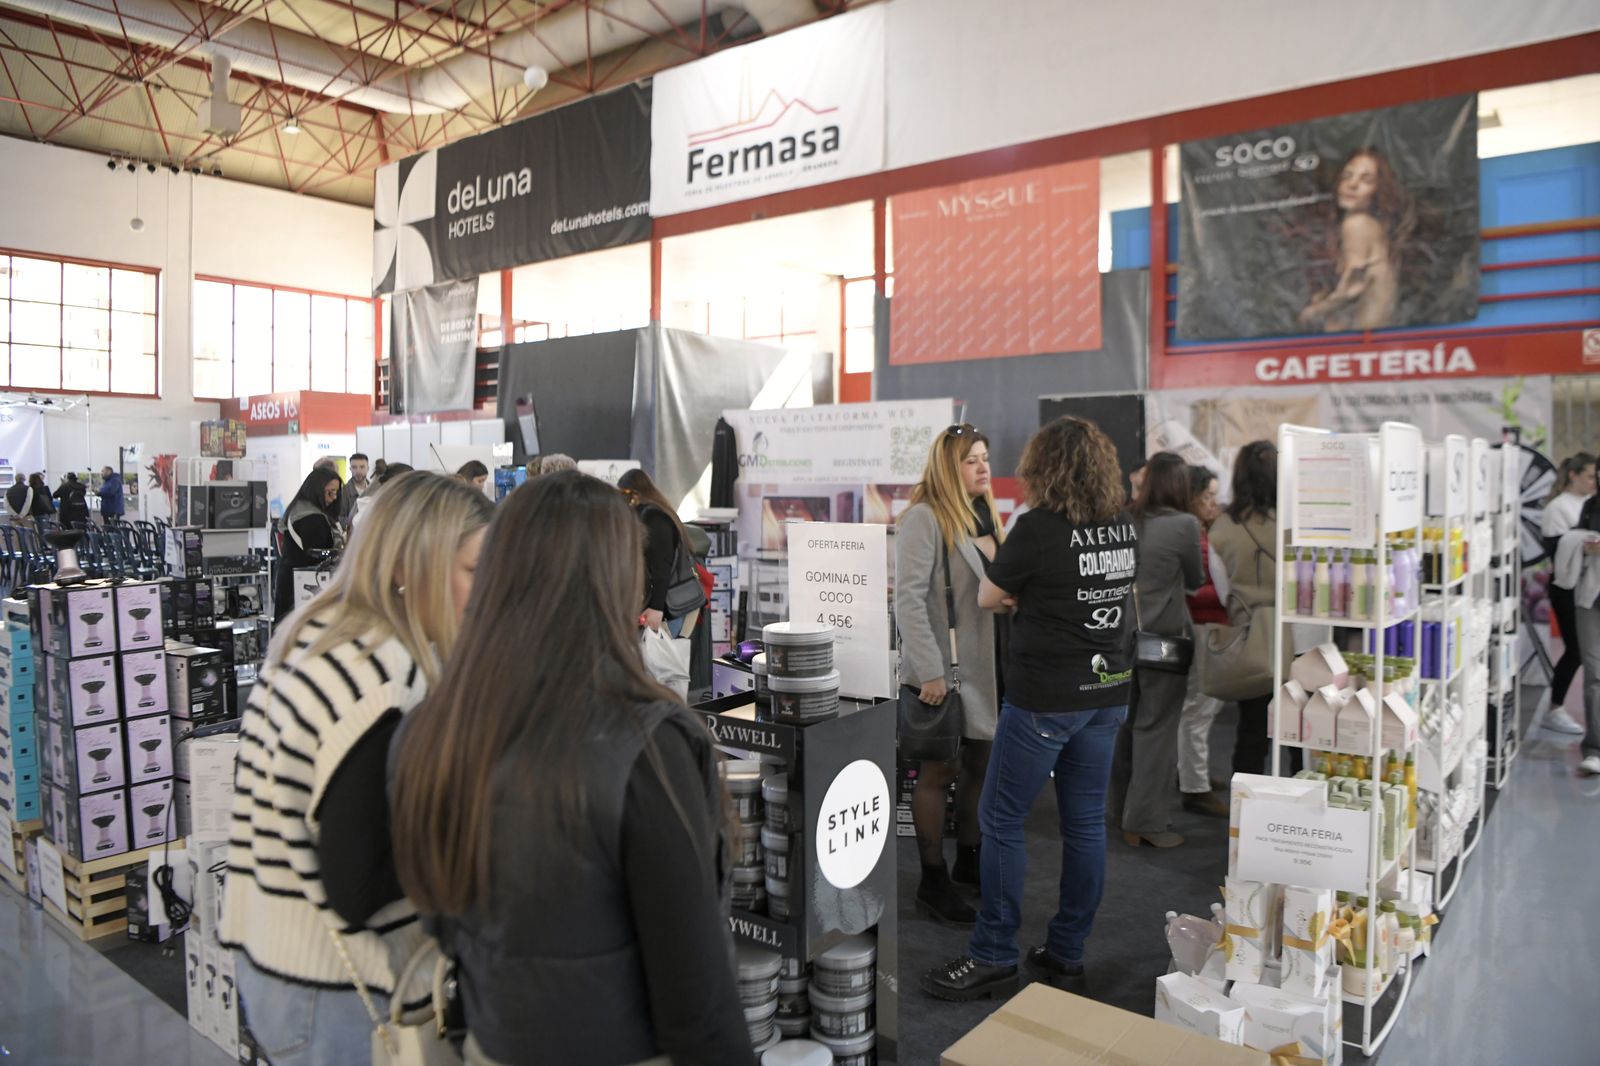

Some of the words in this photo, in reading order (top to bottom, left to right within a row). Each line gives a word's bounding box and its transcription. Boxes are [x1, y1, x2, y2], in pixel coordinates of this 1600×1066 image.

[687, 125, 840, 184] Fermasa
[1215, 136, 1296, 167] SOCO
[447, 167, 532, 215] deLuna
[448, 211, 495, 240] HOTELS
[550, 200, 650, 235] deLunahotels.com
[1254, 342, 1477, 382] CAFETERÍA
[250, 401, 280, 421] ASEOS
[749, 413, 785, 425] NUEVA
[793, 409, 879, 423] PLATAFORMA
[888, 408, 915, 418] WEB
[807, 540, 839, 550] OFERTA
[840, 541, 865, 551] FERIA
[1070, 524, 1137, 547] AXENIA
[1079, 548, 1135, 576] COLORANDA
[805, 571, 850, 585] GOMINA
[852, 574, 868, 586] DE
[1077, 583, 1131, 601] biomed
[820, 591, 853, 604] COCO
[706, 714, 782, 749] RAYWELL
[828, 795, 880, 831] STYLE
[828, 817, 880, 855] LINK
[1267, 823, 1309, 837] OFERTA
[1311, 829, 1343, 841] FERIA
[728, 916, 783, 948] YWELL
